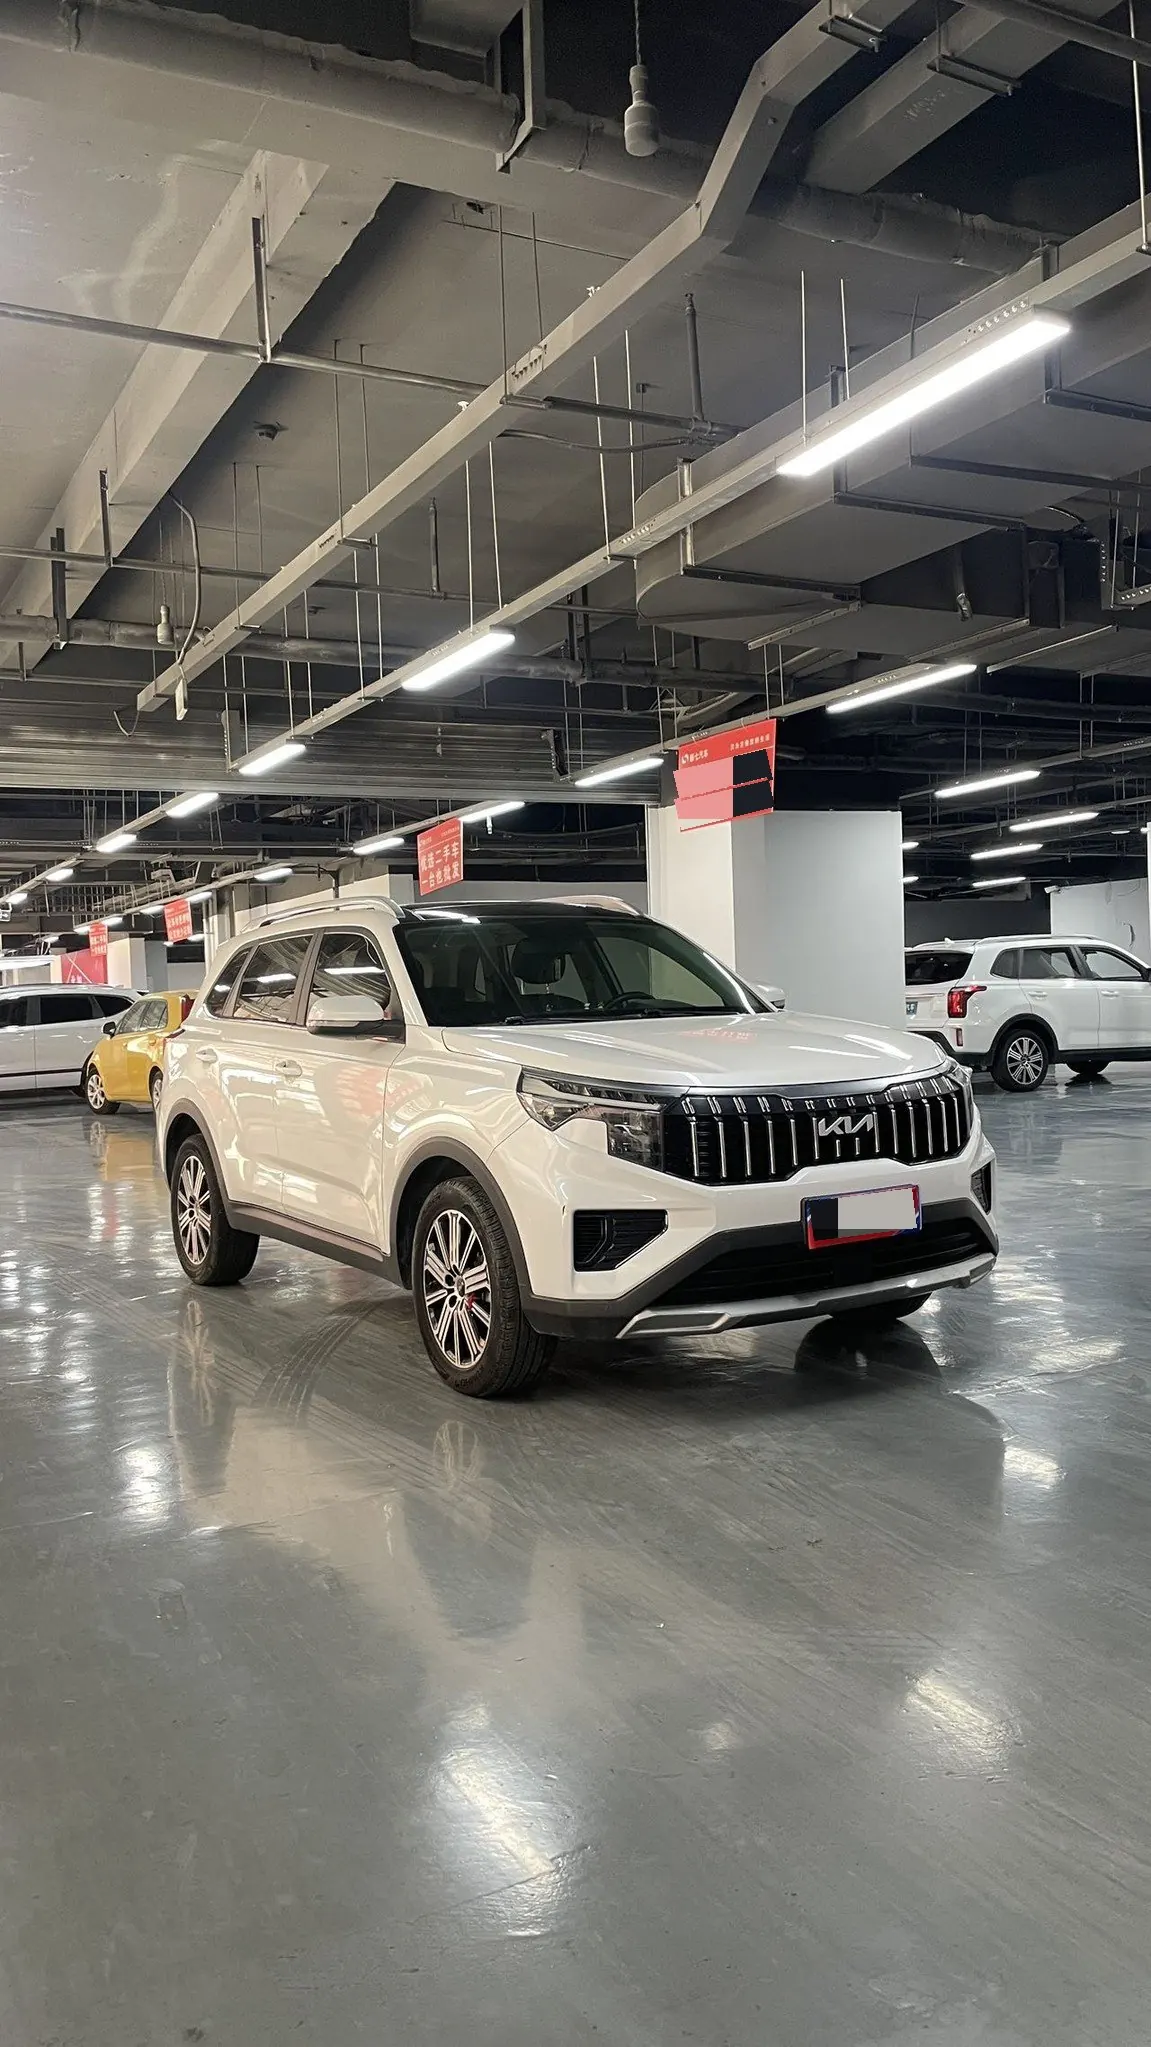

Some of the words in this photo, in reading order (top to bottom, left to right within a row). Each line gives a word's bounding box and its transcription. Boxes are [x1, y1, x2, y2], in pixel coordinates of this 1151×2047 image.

[421, 861, 460, 888] 一台也批发
[818, 1113, 874, 1137] KIA
